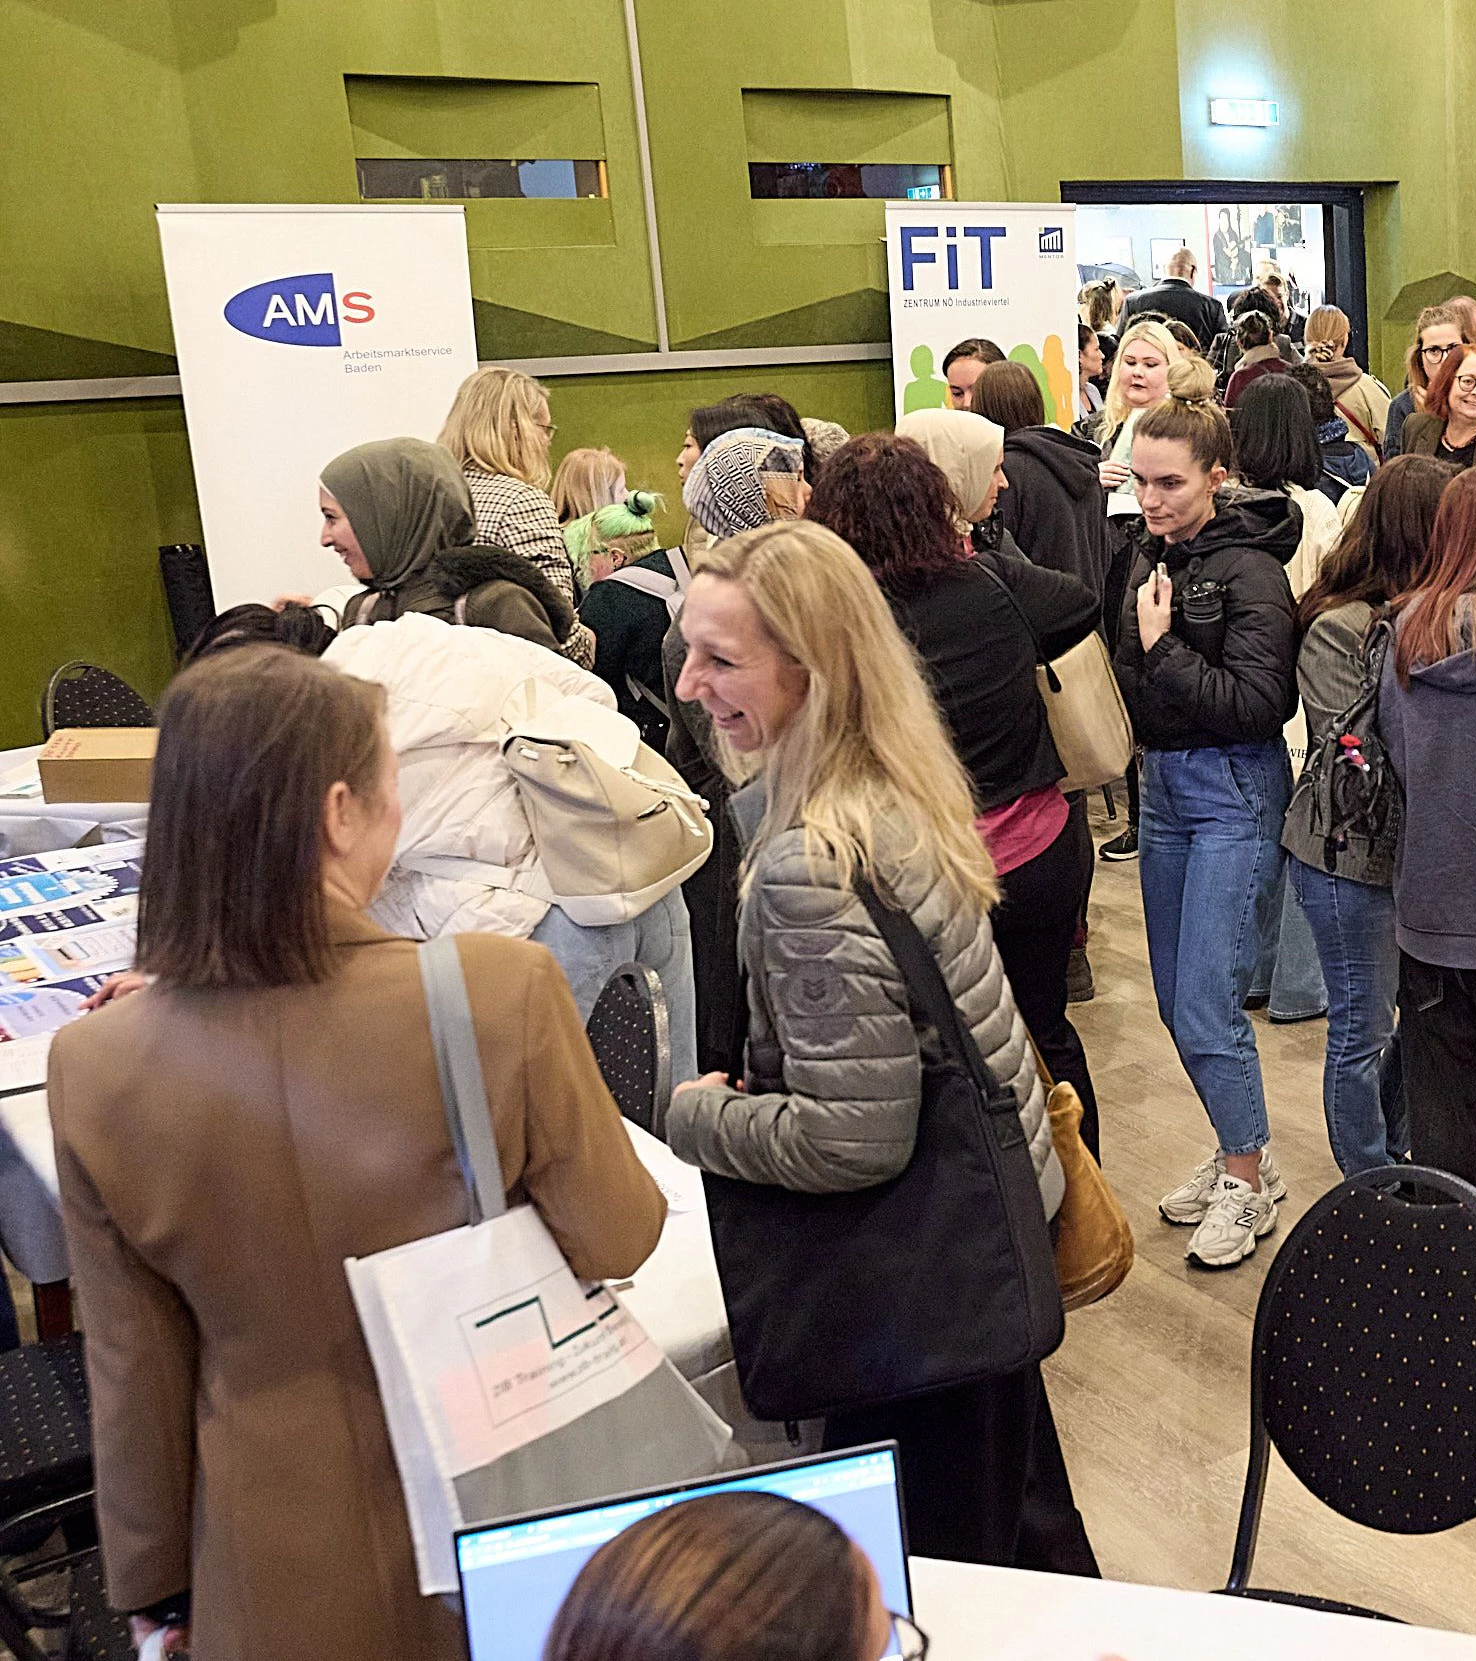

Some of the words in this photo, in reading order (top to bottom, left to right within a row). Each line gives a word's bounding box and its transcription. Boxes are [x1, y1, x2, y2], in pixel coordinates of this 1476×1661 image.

[900, 226, 1006, 290] FiT
[263, 291, 375, 328] AMS
[903, 299, 940, 308] ZENTRUM
[942, 298, 954, 307] NÖ
[955, 297, 1010, 307] Industrieviertel
[343, 346, 452, 360] Arbeitsmarktservice
[344, 363, 382, 374] Baden
